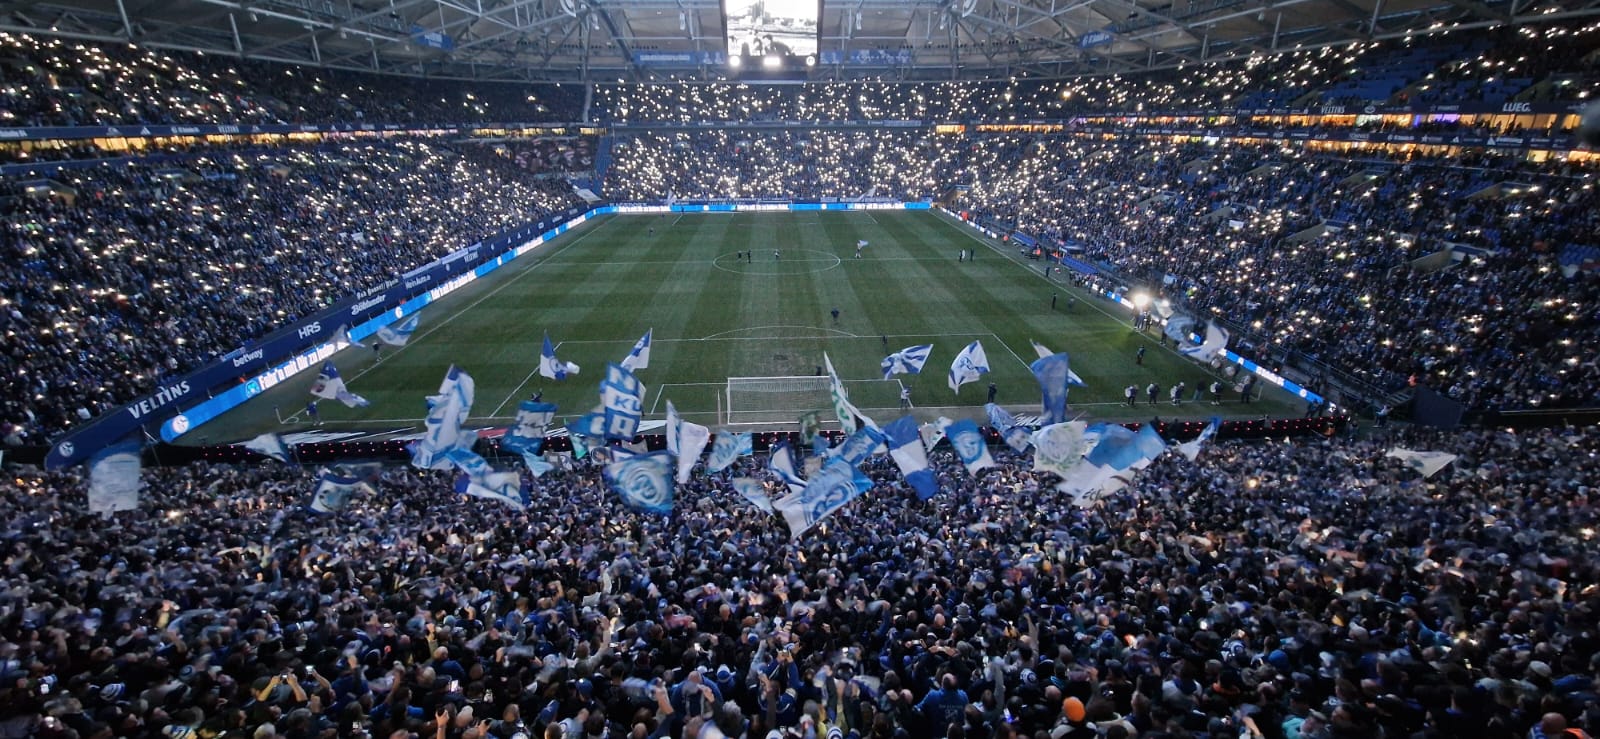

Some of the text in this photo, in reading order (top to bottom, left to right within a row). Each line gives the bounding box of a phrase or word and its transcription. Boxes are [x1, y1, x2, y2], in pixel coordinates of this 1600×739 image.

[1502, 102, 1531, 113] LUEG.
[298, 321, 321, 339] HRS
[233, 348, 263, 368] betway
[128, 381, 190, 418] VELTINS
